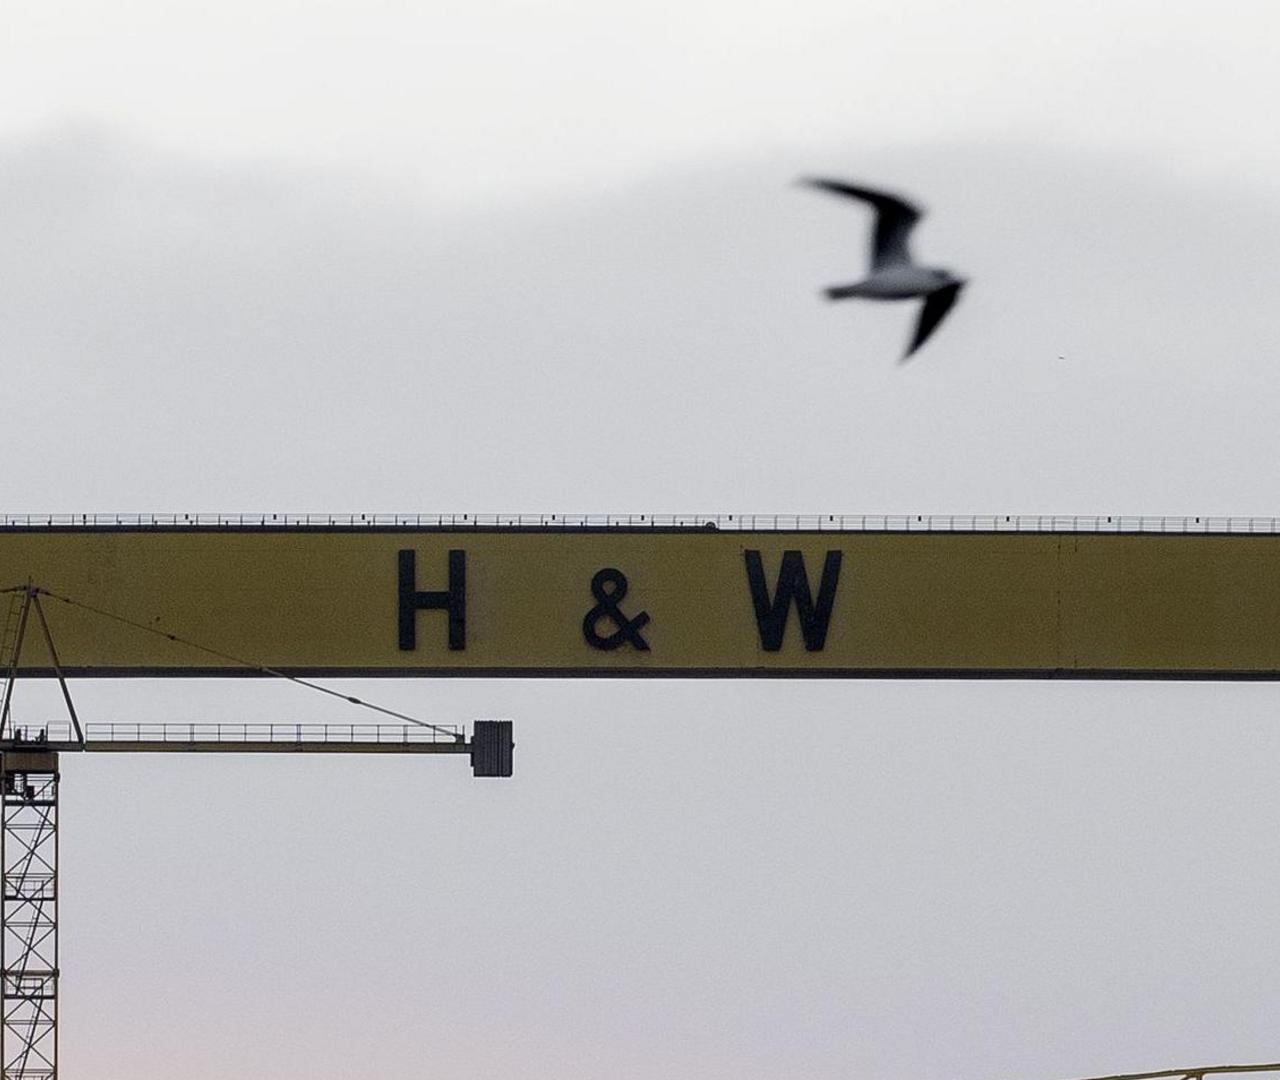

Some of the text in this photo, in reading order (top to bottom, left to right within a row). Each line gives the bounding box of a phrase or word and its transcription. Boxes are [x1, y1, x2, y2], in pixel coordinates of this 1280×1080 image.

[398, 549, 842, 652] H & W
